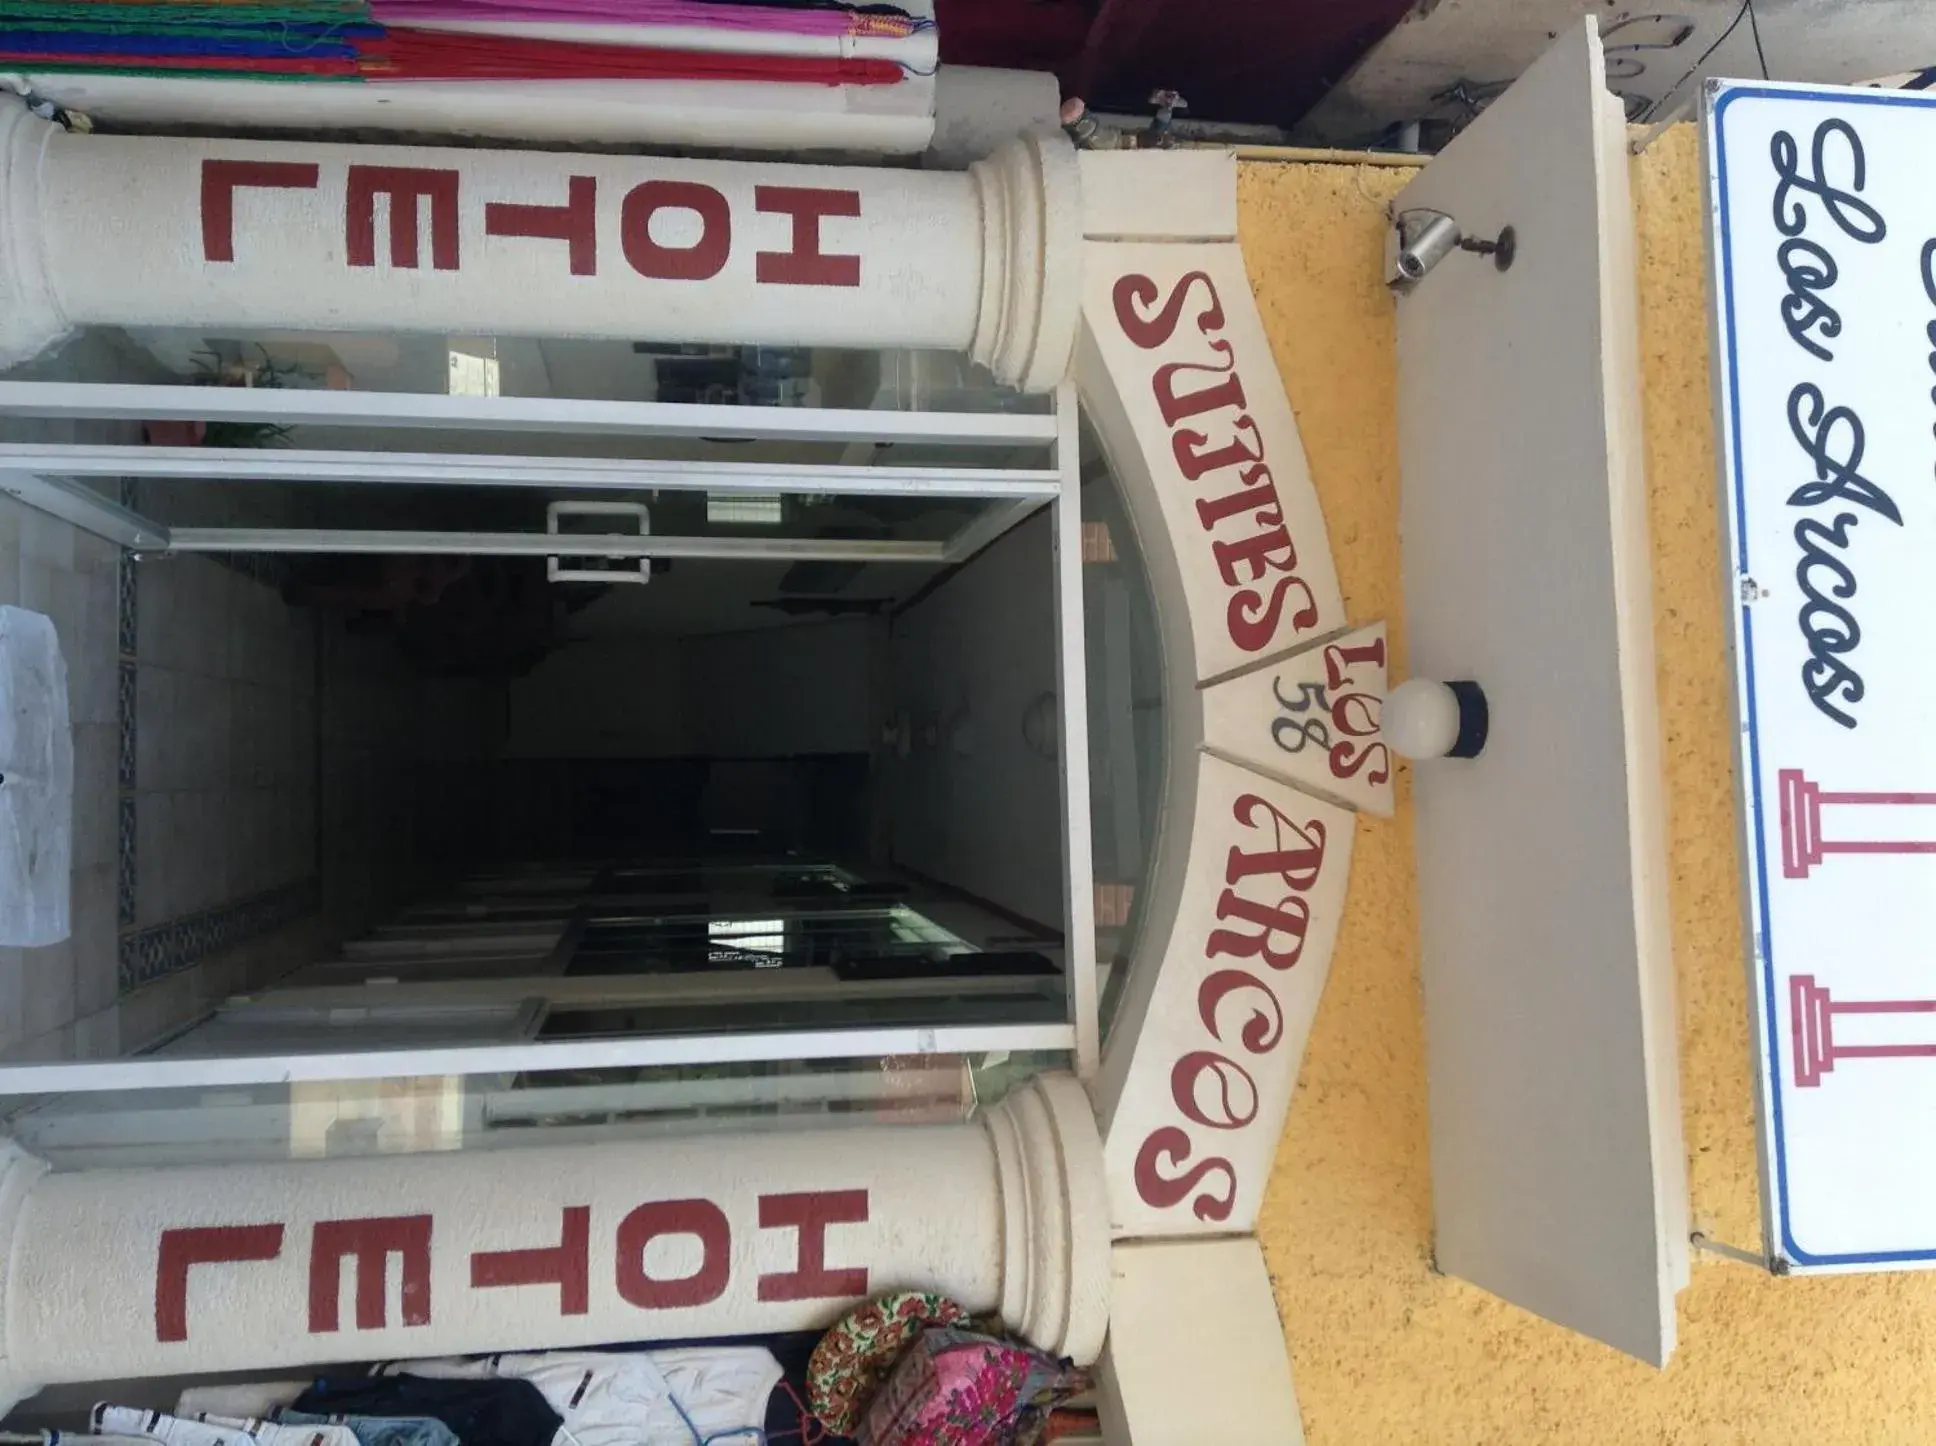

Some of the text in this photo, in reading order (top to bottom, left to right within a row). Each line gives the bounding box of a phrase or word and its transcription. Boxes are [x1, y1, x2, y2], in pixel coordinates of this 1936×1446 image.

[200, 159, 861, 288] HOTEL
[1770, 118, 1904, 729] Los Arcos
[1111, 271, 1389, 1223] SUITES LOS ARCOS
[1270, 675, 1333, 754] 58
[155, 1188, 869, 1343] HOTEL
